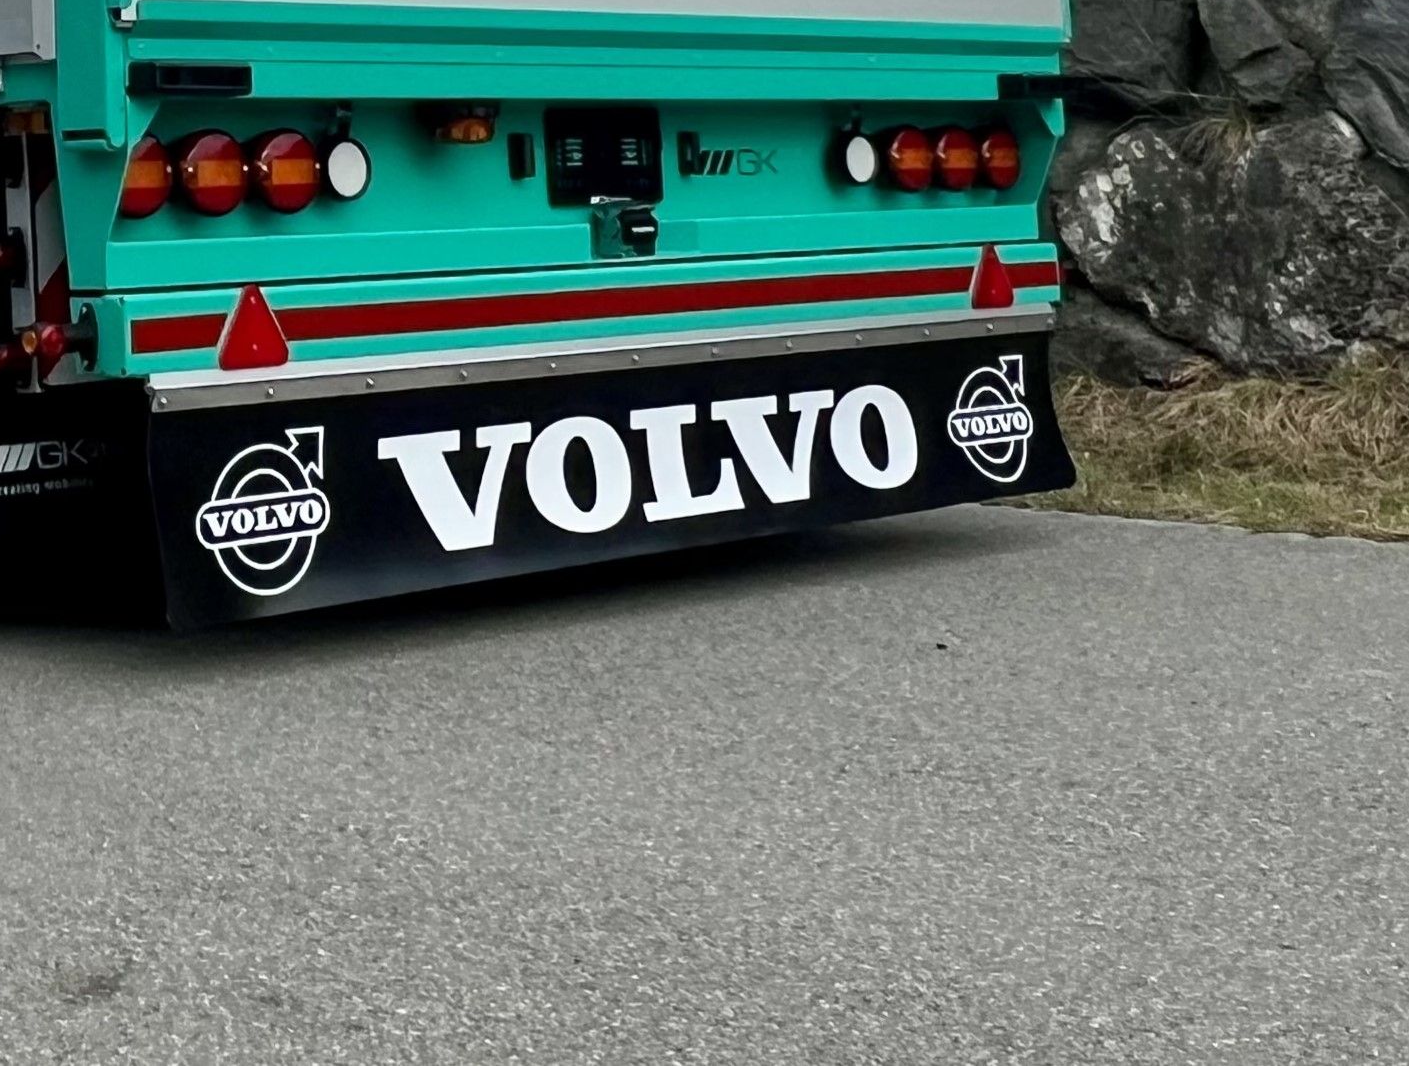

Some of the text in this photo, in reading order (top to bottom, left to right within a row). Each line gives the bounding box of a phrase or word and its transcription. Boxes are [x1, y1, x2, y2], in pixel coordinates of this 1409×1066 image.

[736, 148, 779, 176] GK
[951, 410, 1028, 438] VOLVO
[36, 438, 89, 470] GK
[378, 384, 919, 552] VOLVO
[202, 499, 323, 538] VOLVO
